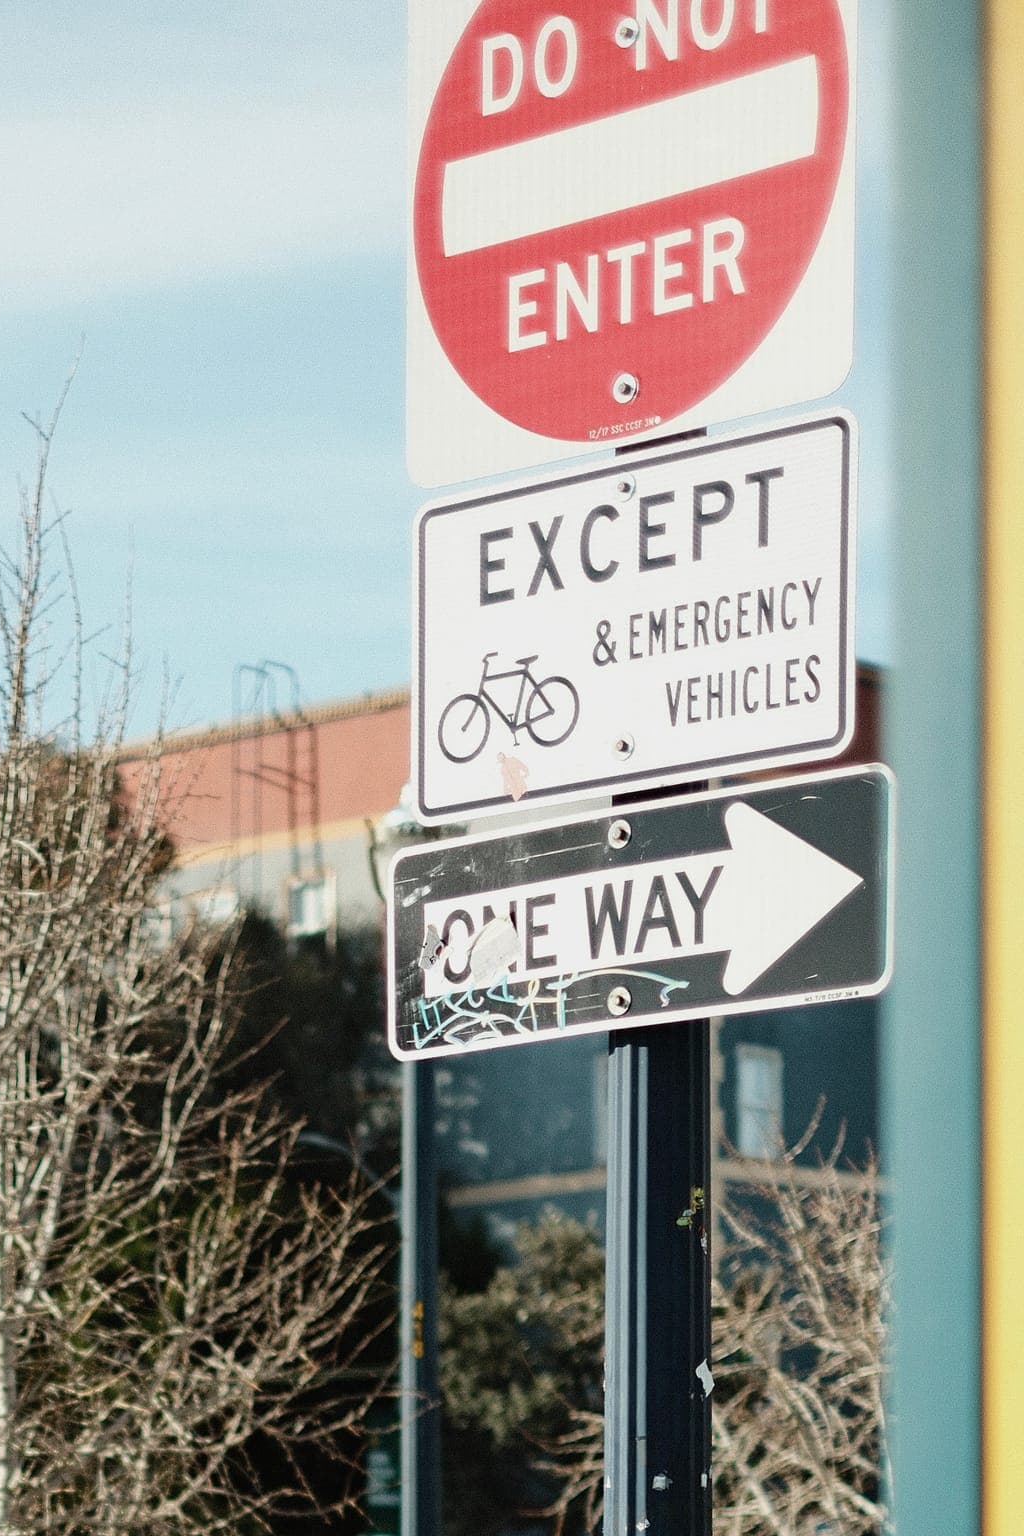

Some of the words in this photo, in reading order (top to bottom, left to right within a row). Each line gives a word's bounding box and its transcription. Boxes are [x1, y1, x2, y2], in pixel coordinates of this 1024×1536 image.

[482, 15, 577, 117] DO
[508, 217, 745, 353] ENTER
[480, 466, 784, 606] EXCEPT
[629, 577, 822, 660] EMERGENCY
[665, 655, 821, 727] VEHICLES
[584, 866, 724, 960] WAY
